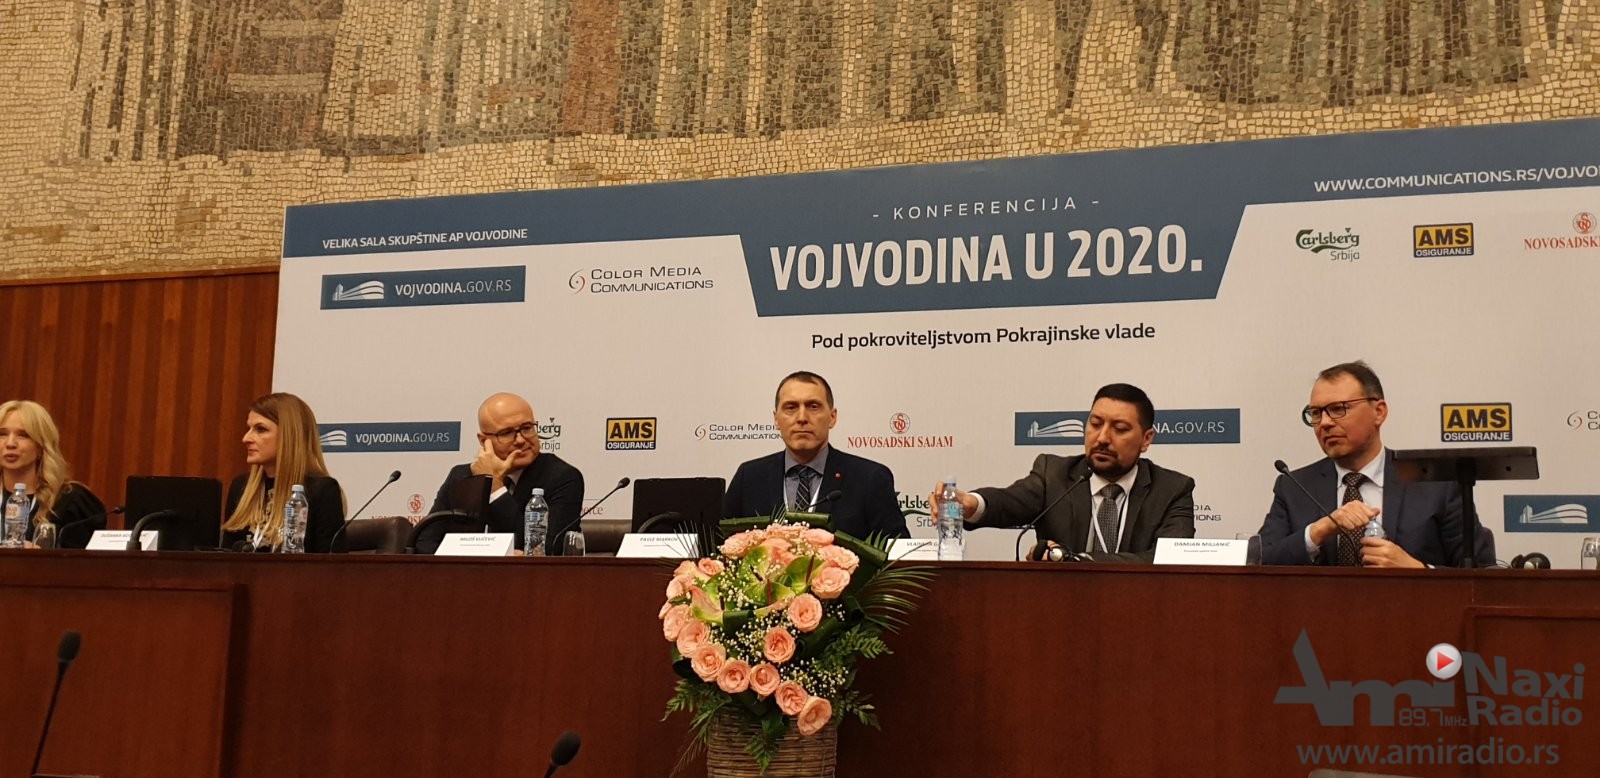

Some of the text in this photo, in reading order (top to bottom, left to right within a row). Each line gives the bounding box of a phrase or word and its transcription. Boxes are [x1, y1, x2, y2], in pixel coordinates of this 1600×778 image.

[1314, 165, 1600, 192] WWW.COMMUNICATIONS.RS/VOJVO
[893, 196, 1077, 220] KONFERENCIJA
[322, 228, 528, 250] VELIKA SALA SKUPŠTINE AP VOJVODINE
[1295, 227, 1360, 253] Carlsberg
[1418, 227, 1469, 247] AMS
[1524, 236, 1600, 250] NOVOSADSK
[770, 224, 1203, 291] VOJVODINA U 2020.
[1330, 250, 1360, 262] Srbija
[1415, 247, 1472, 257] OSIGURANJE
[395, 278, 512, 298] VOJVODINA.GOV.RS
[812, 323, 1156, 351] Pod pokroviteljstvom Pokrajinske vlade
[1446, 408, 1507, 429] AMS
[610, 422, 653, 439] AMS
[748, 423, 776, 431] MEDI
[1152, 421, 1225, 434] NA.GOV.RS
[355, 431, 450, 446] VOJVODINA.GOV.RS
[709, 432, 783, 441] COMMUNICATION
[847, 435, 953, 448] NOVOSADSKI SAJAM
[1443, 430, 1510, 441] OSIGURANJE
[541, 440, 561, 452] rbija
[607, 441, 655, 450] OSIGURANJE
[898, 494, 931, 509] rlsbe
[916, 516, 934, 527] Srb
